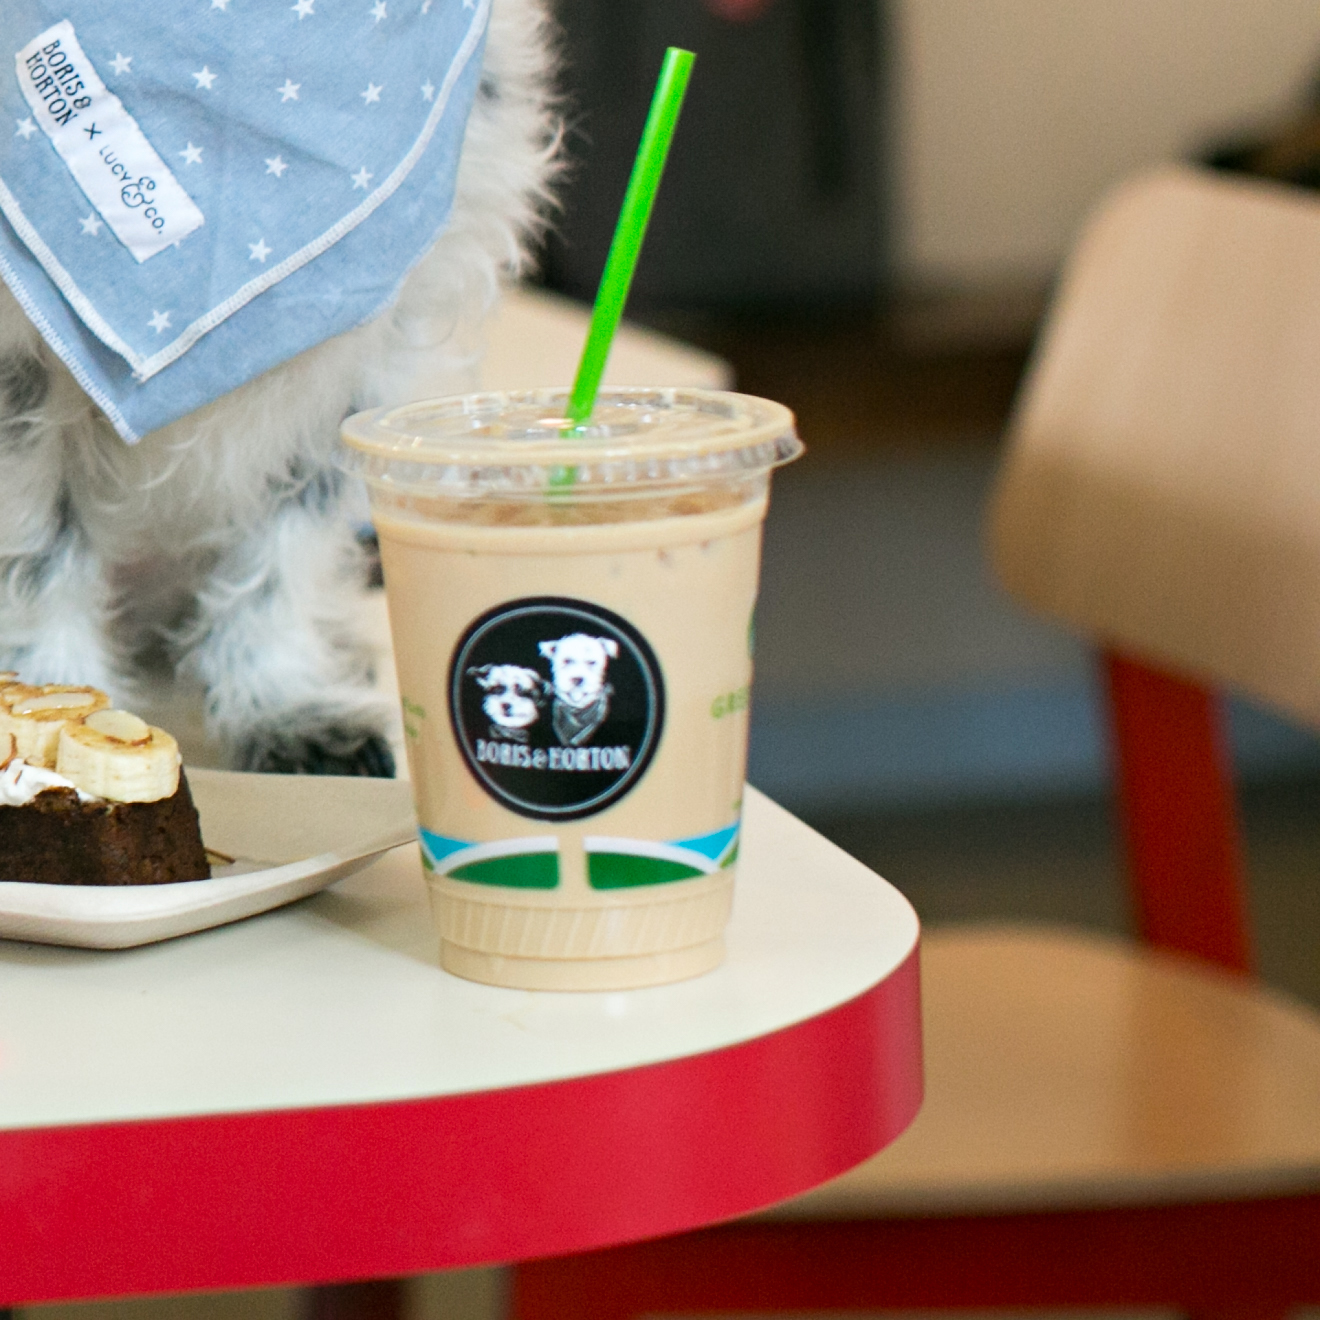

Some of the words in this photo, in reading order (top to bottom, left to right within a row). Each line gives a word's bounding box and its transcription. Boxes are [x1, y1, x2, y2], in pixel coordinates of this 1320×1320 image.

[25, 50, 78, 126] HORTON
[42, 39, 85, 96] BORIS
[476, 738, 531, 768] BORIS
[548, 744, 630, 771] HORTON
